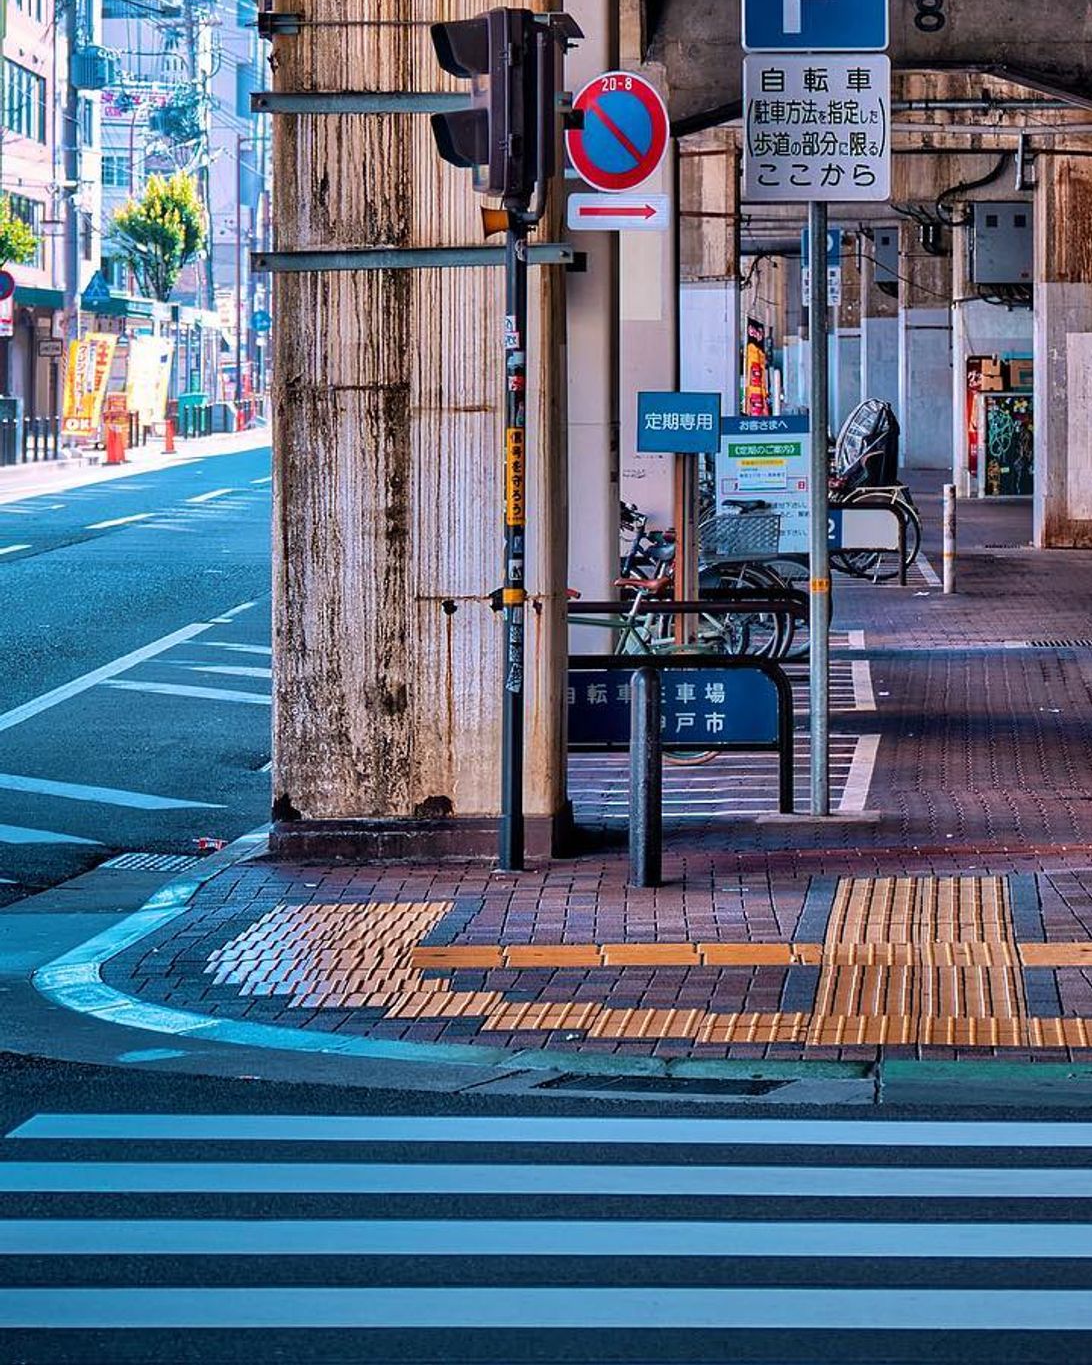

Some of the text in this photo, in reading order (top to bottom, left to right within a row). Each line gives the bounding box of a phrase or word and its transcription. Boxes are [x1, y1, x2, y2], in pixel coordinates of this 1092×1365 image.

[761, 67, 872, 93] 自転車
[758, 163, 875, 186] ここから
[65, 418, 89, 431] OK
[645, 412, 713, 431] 定期専用
[739, 420, 788, 431] お客さまへ
[567, 682, 725, 704] 転車車場
[660, 711, 725, 733] 戸市
